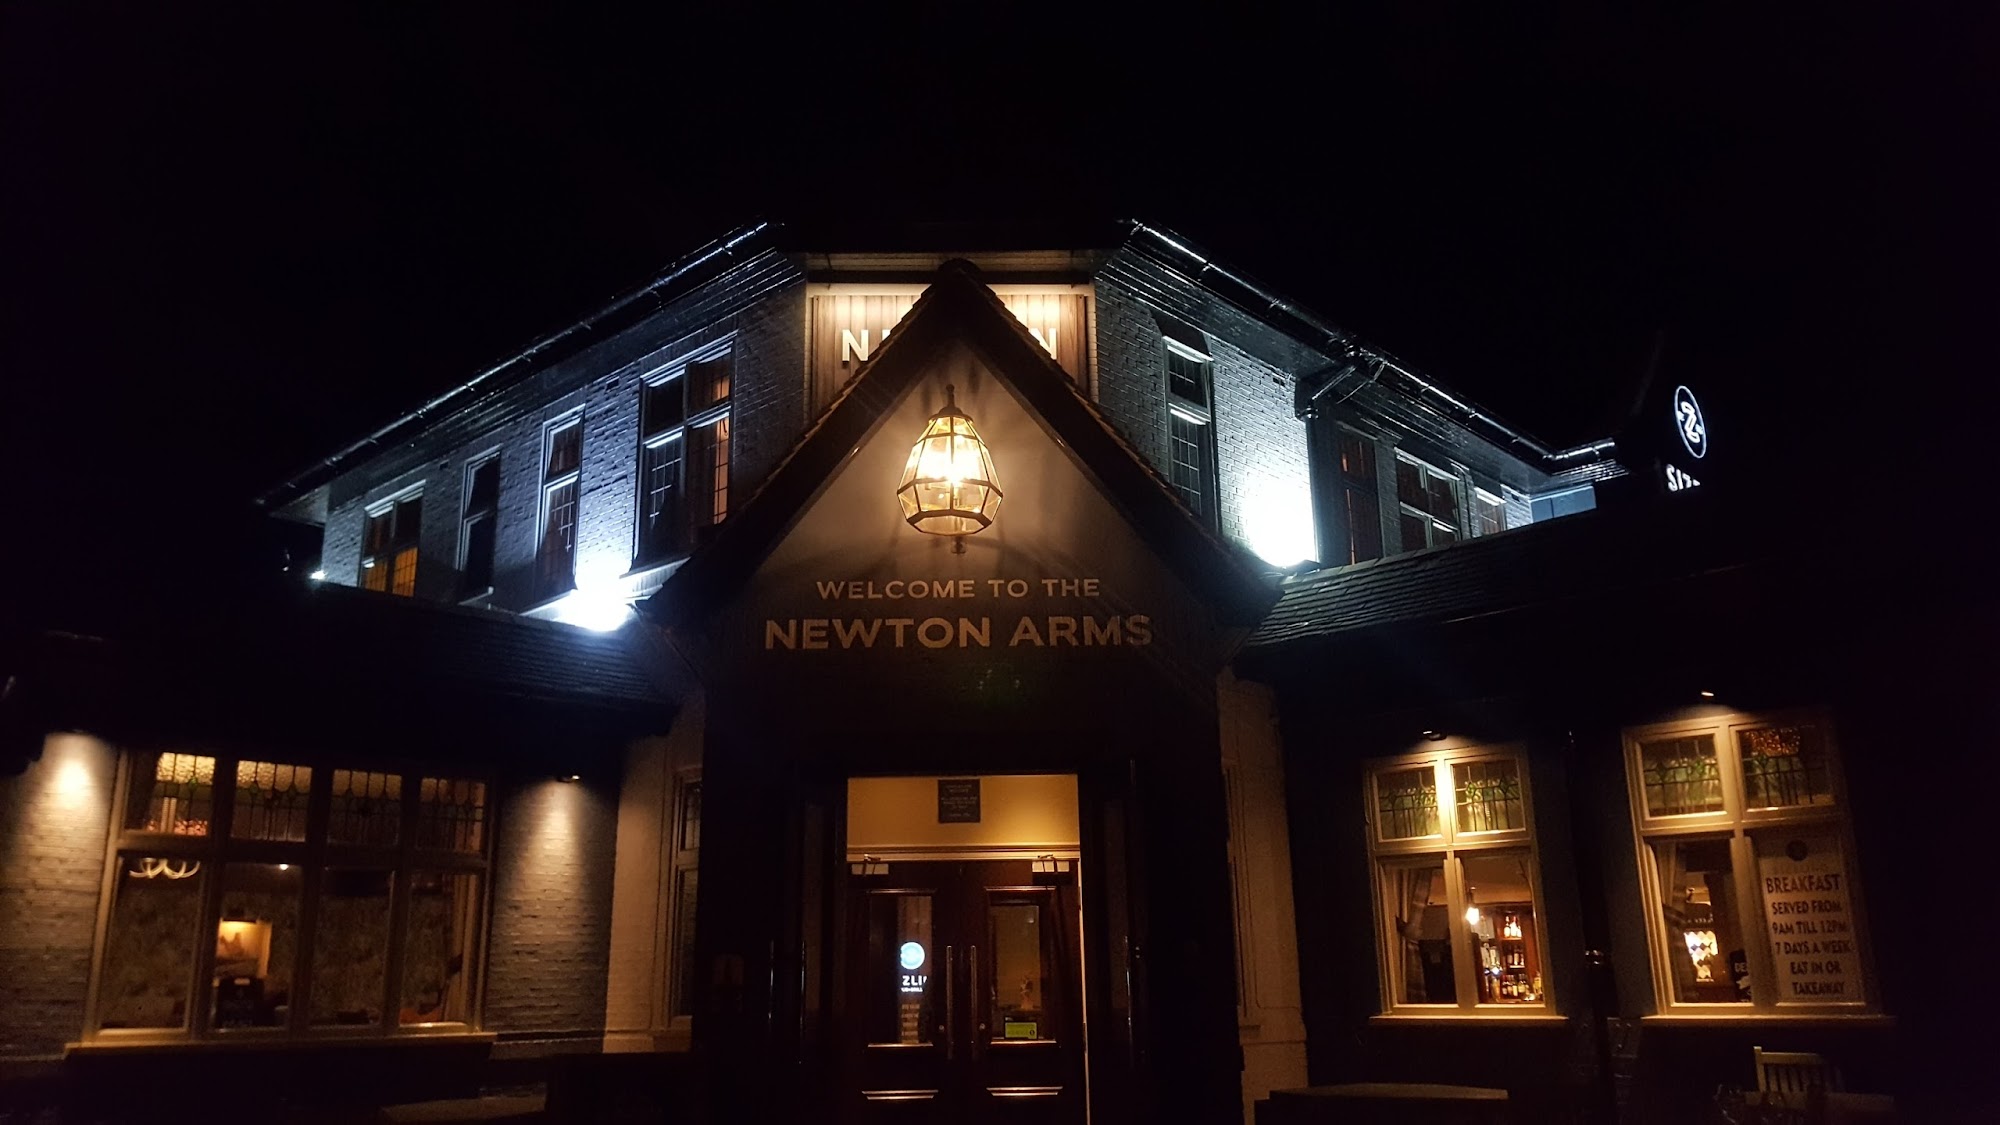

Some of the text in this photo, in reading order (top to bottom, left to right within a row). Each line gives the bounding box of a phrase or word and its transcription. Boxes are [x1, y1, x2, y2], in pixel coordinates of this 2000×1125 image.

[816, 578, 1100, 599] WELCOME TO THE
[765, 614, 1153, 650] NEWTON ARMS
[1766, 874, 1840, 893] BREAKFAST
[1772, 900, 1842, 915] SERVED FROM
[1772, 919, 1847, 935] 9AM TILL 12PM
[1775, 940, 1850, 955] 7 DAYS A WEEK
[1790, 960, 1842, 975] EAT IN OR
[1792, 981, 1845, 995] TAKEAWAY
